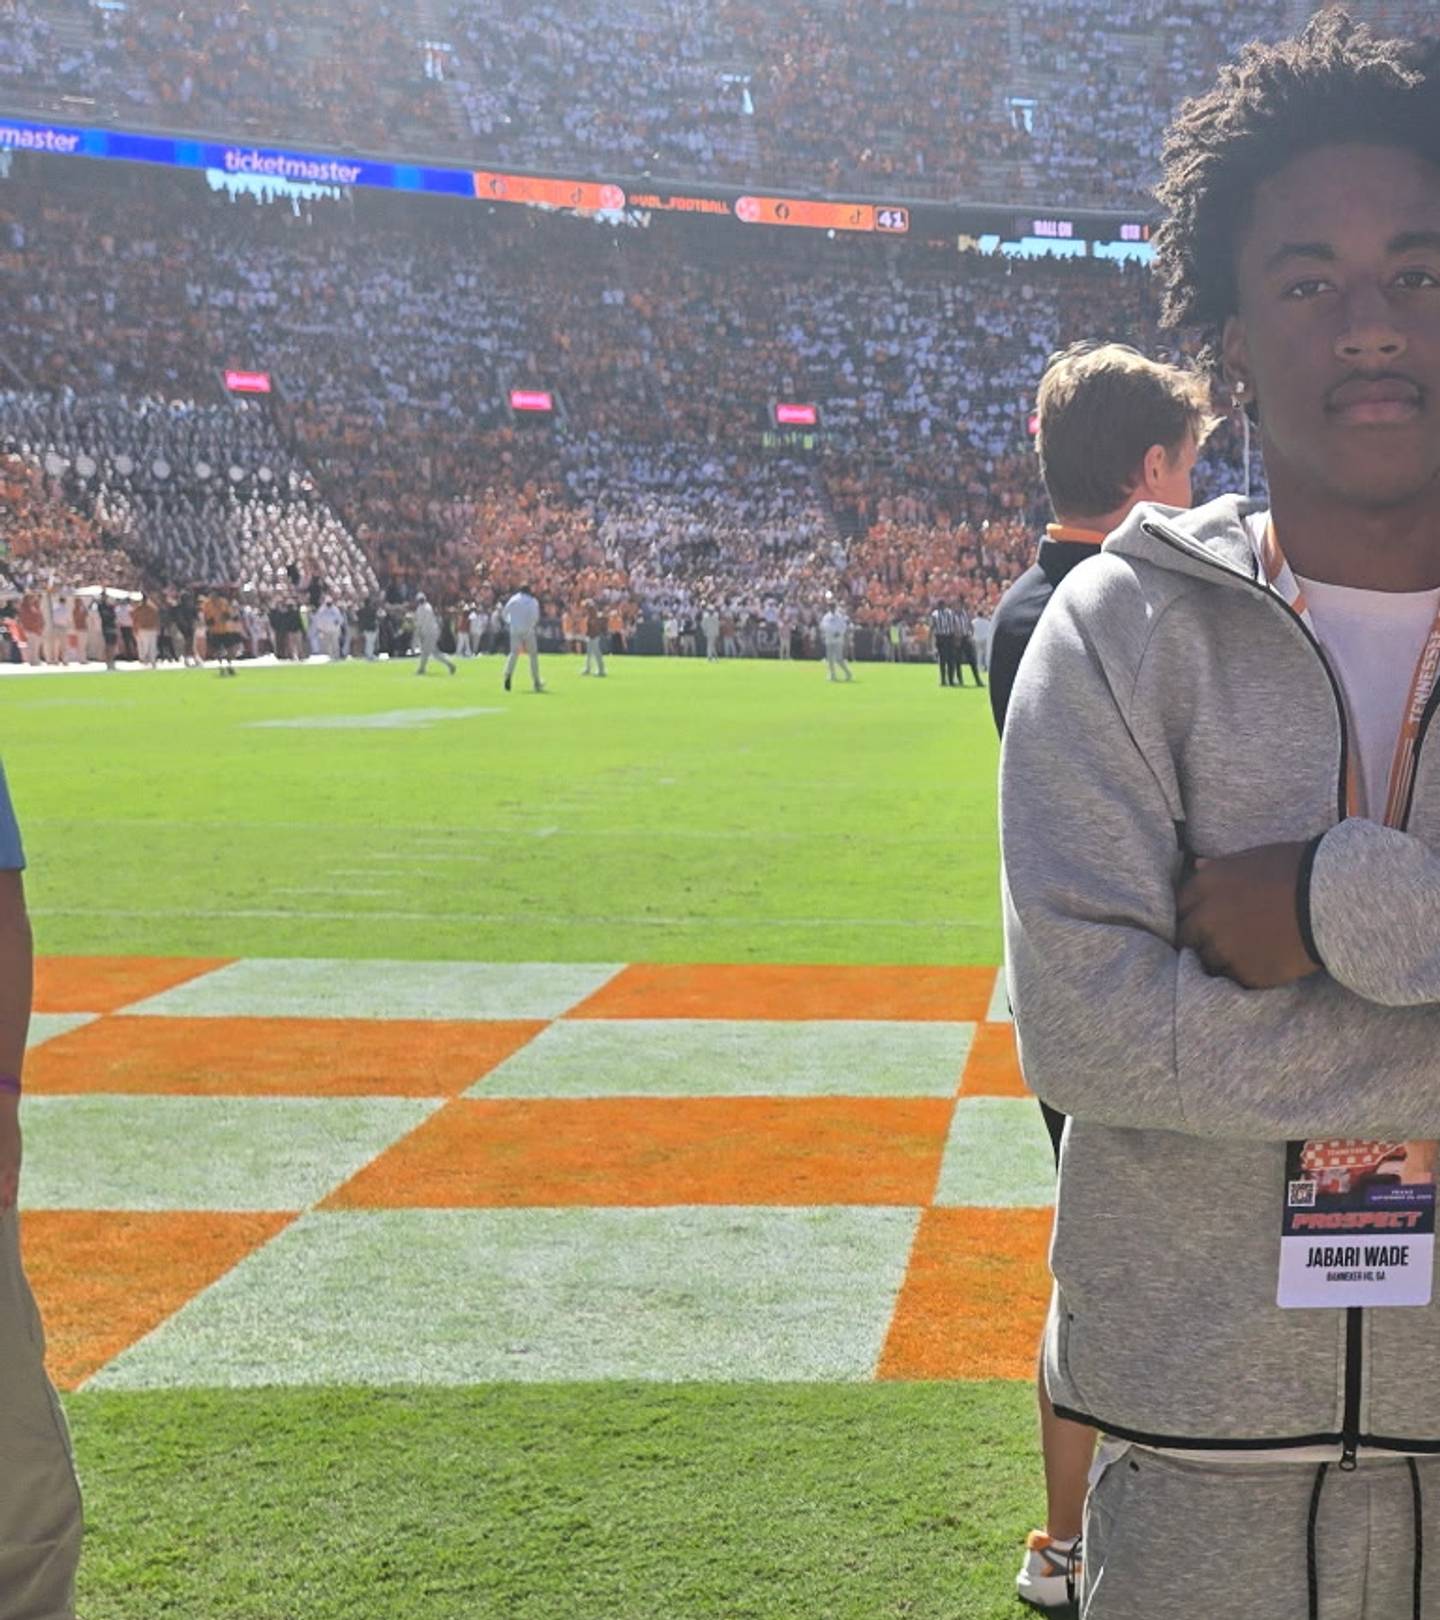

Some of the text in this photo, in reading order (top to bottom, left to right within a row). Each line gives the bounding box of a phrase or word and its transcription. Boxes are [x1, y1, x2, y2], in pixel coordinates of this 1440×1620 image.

[225, 150, 361, 182] ticketmaster
[1292, 1211, 1423, 1230] PROSPECT
[1306, 1245, 1410, 1268] JABARI WADE
